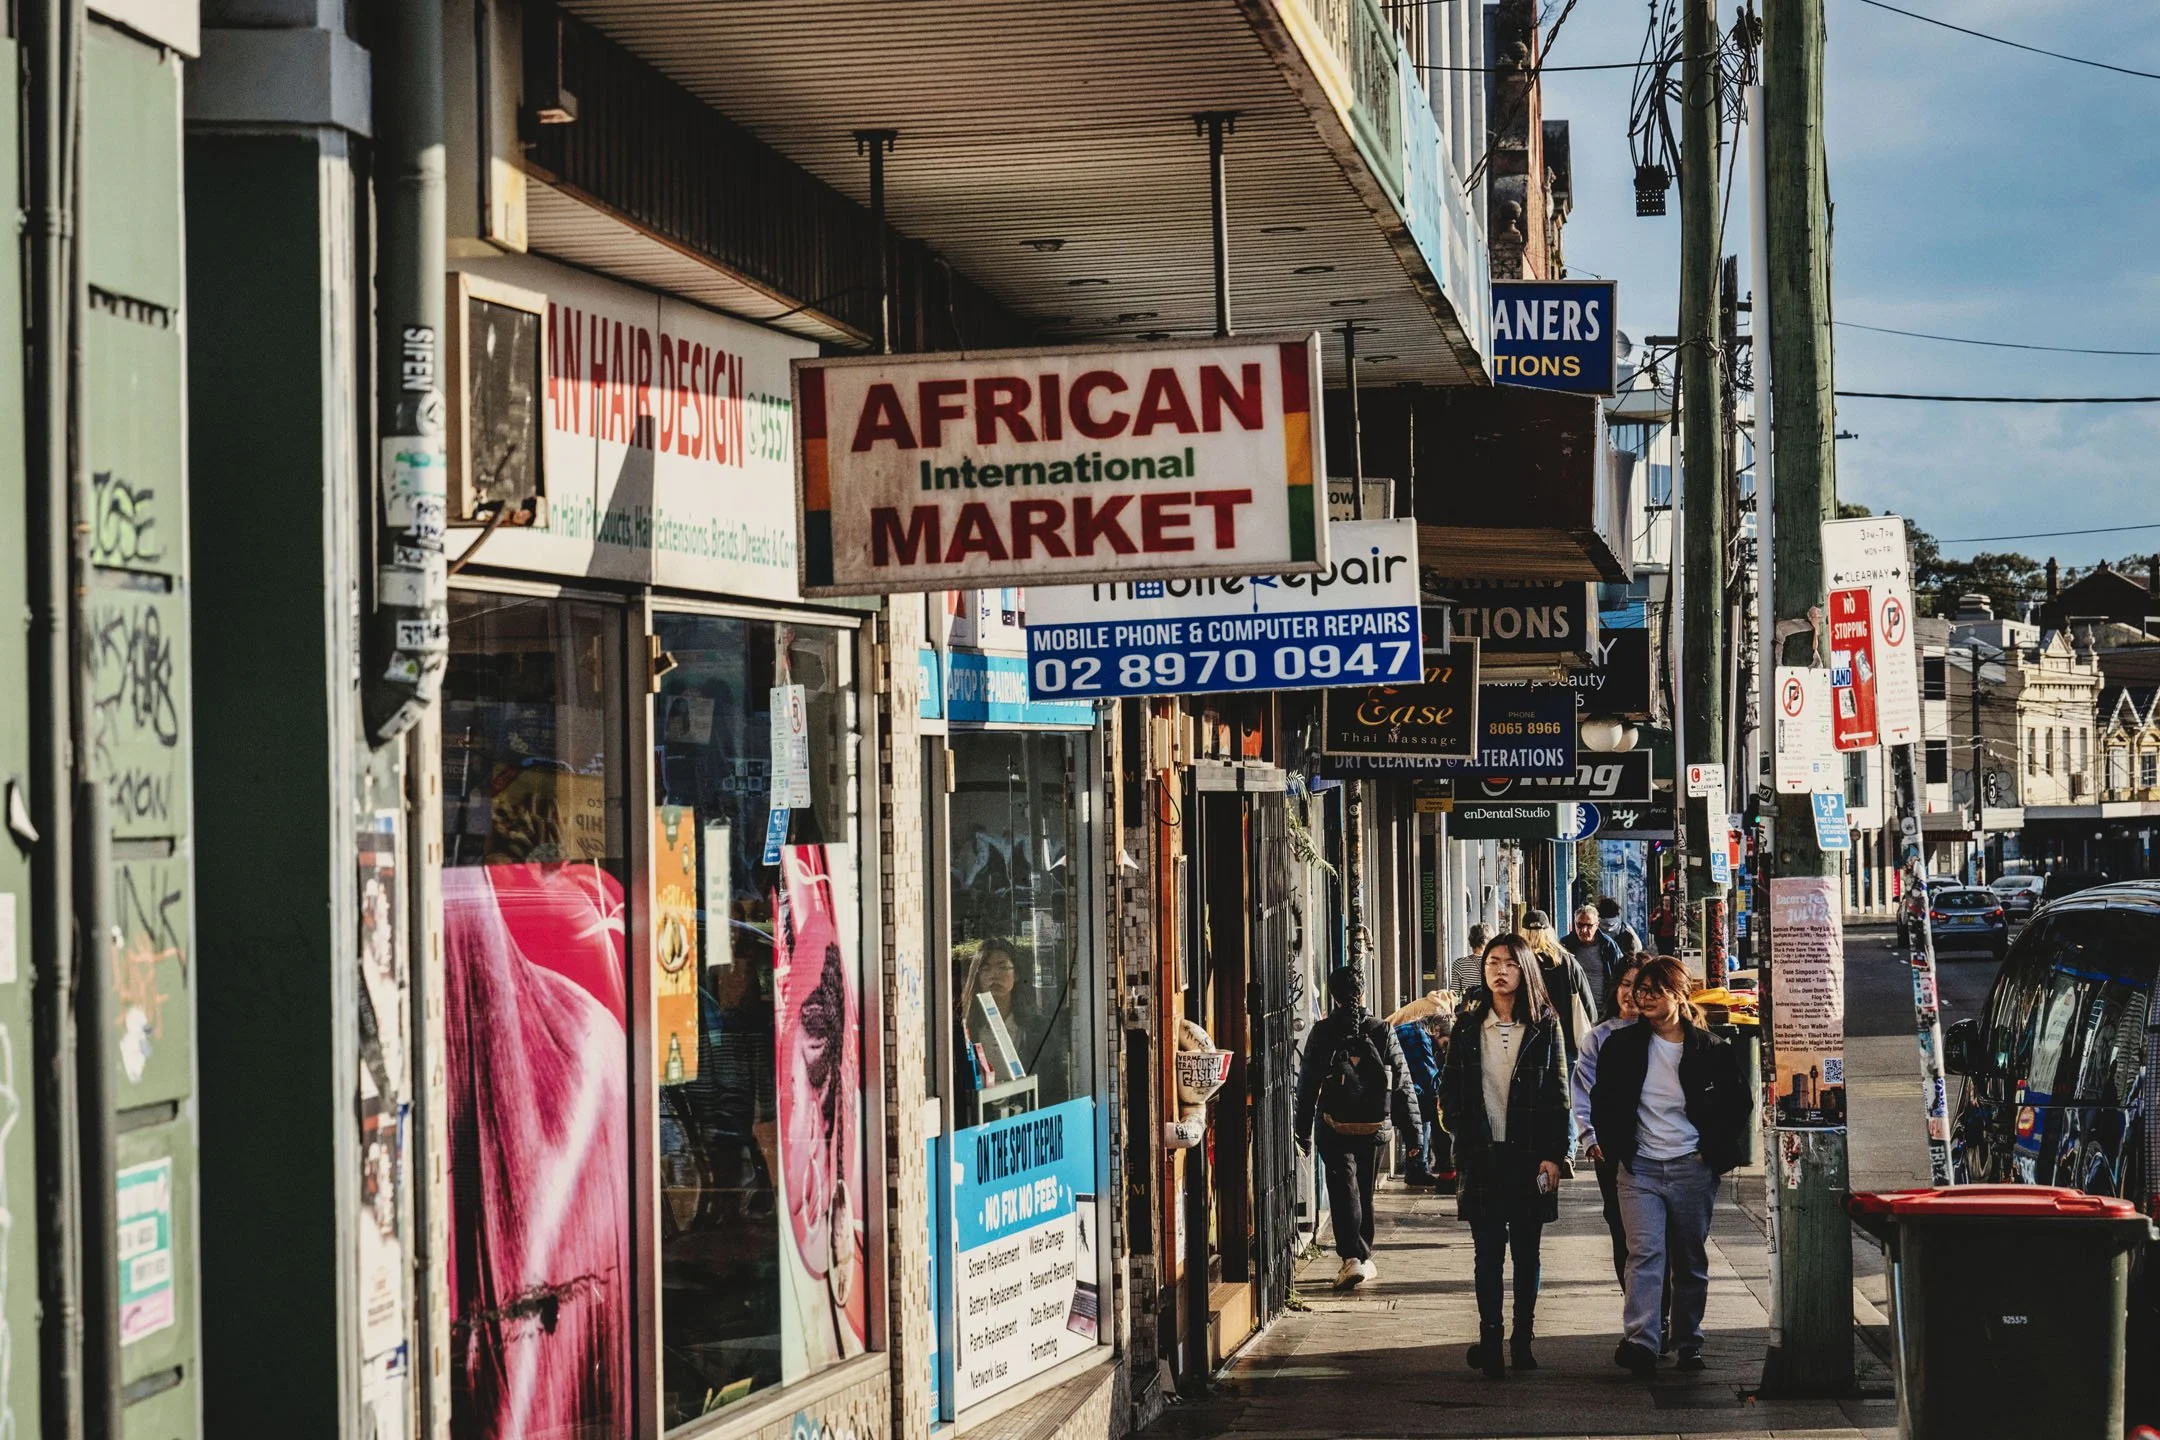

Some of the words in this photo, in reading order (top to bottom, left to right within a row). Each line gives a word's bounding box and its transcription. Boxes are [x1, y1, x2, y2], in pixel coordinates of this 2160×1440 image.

[1491, 300, 1600, 343] ANERS
[1493, 355, 1580, 378] TIONS
[547, 302, 582, 434] AN
[590, 314, 653, 450] HAIR
[660, 333, 743, 468] DESIGN
[850, 362, 1264, 454] AFRICAN
[919, 446, 1196, 492] International
[871, 488, 1253, 569] MARKET
[1845, 569, 1889, 583] CLEARWAY
[1843, 594, 1856, 615] NO
[1033, 627, 1109, 651] MOBILE
[1111, 623, 1183, 648] PHONE
[1188, 623, 1202, 645] &
[1205, 617, 1321, 644] COMPUTER
[1326, 613, 1411, 637] REPAIRS
[1449, 605, 1571, 639] TIONS
[1834, 620, 1868, 640] STOPPING
[1035, 656, 1101, 692] 02
[1119, 648, 1257, 689] 8970
[1273, 641, 1411, 682] 0947
[1831, 669, 1851, 686] LAND
[1356, 702, 1454, 725] Ease
[1489, 722, 1523, 735] 8065
[1527, 722, 1561, 735] 8966
[1341, 732, 1378, 743] Thai
[1387, 732, 1457, 747] Massage
[1515, 804, 1551, 818] Studio
[977, 1133, 990, 1186] ON
[991, 1126, 1008, 1180] THE
[1009, 1122, 1032, 1173] SPOT
[1034, 1114, 1064, 1164] REPAIR
[985, 1192, 1000, 1232] NO
[1002, 1187, 1018, 1226] FIX
[1019, 1184, 1033, 1221] NO
[1034, 1175, 1058, 1216] FEES
[968, 1250, 987, 1280] Screen
[987, 1241, 1021, 1272] Replacement
[1029, 1235, 1044, 1261] Water
[1045, 1229, 1065, 1258] Damage
[1029, 1269, 1053, 1295] Password
[1053, 1258, 1076, 1288] Recovery
[969, 1290, 989, 1318] Battery
[990, 1279, 1023, 1310] Replacement
[1030, 1307, 1042, 1330] Data
[1042, 1298, 1066, 1325] Recovery
[970, 1331, 985, 1355] Parts
[985, 1319, 1019, 1350] Replacement
[1031, 1334, 1058, 1365] Formatting
[970, 1366, 993, 1392] Network
[995, 1359, 1008, 1381] Issue
